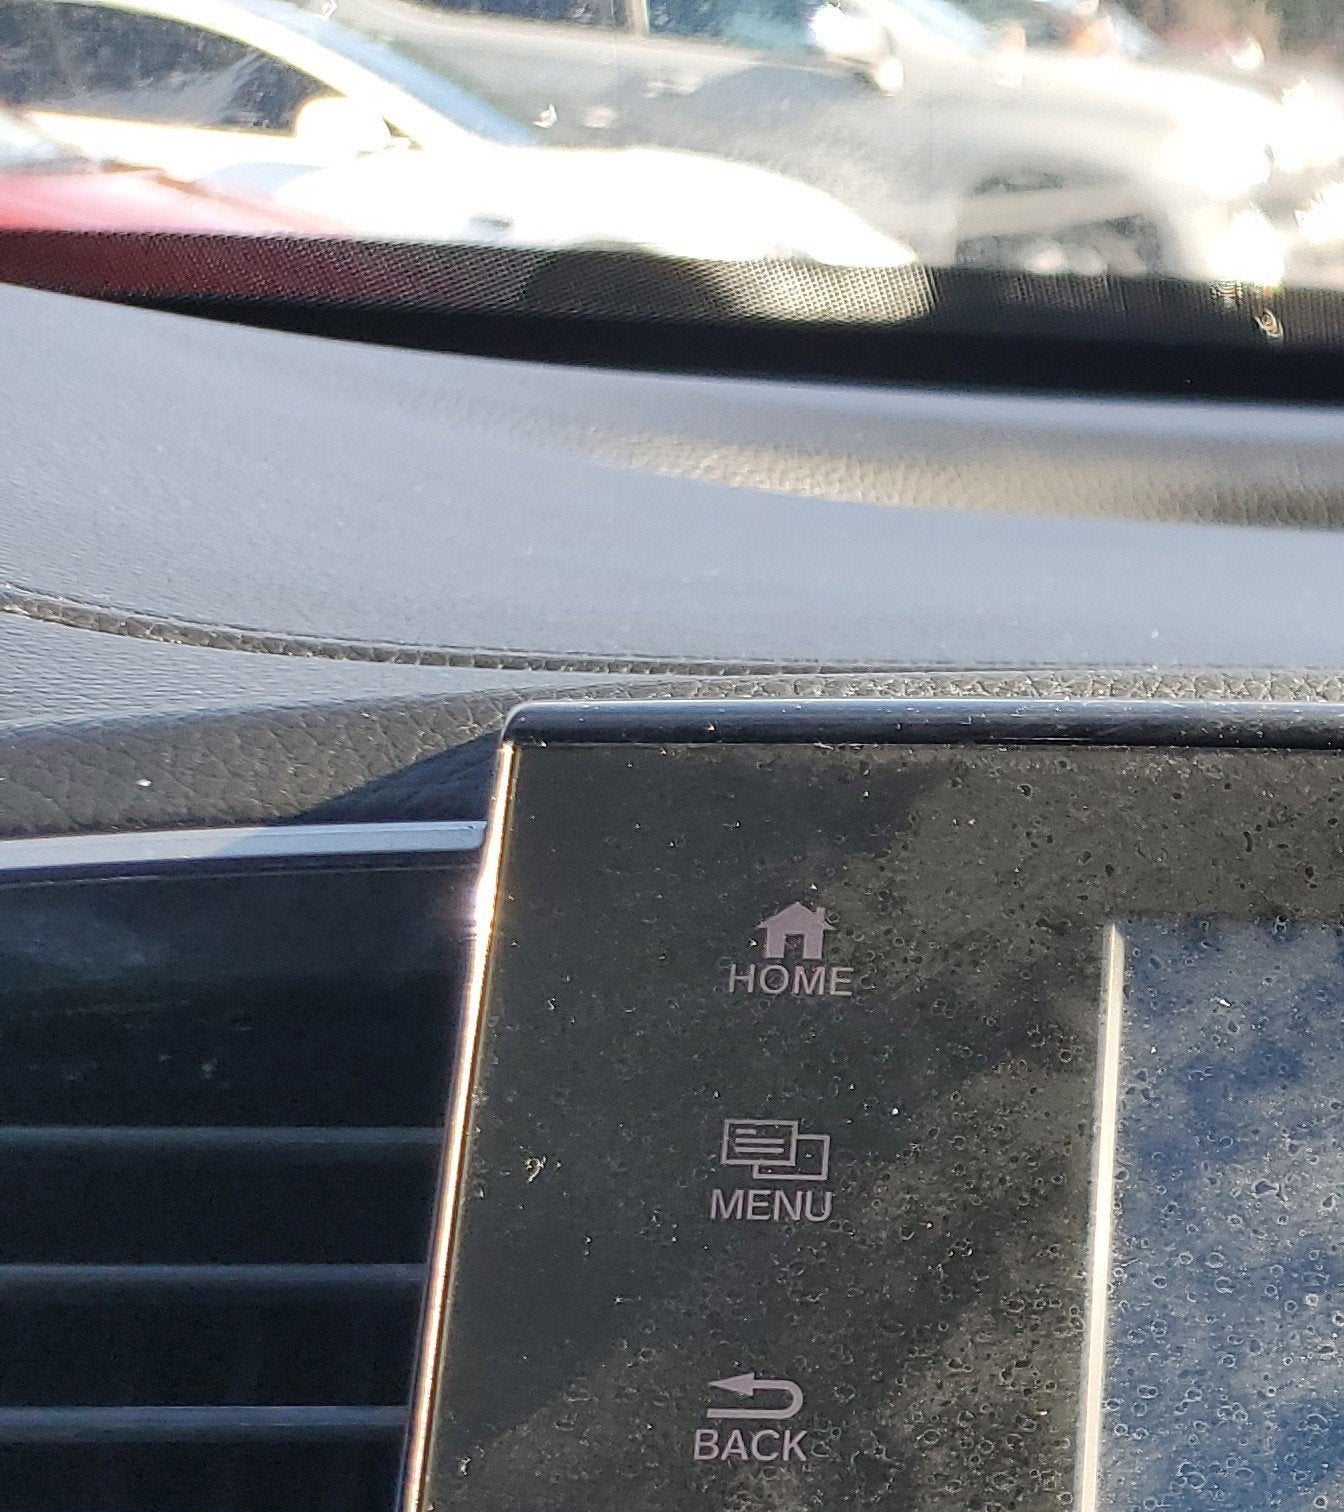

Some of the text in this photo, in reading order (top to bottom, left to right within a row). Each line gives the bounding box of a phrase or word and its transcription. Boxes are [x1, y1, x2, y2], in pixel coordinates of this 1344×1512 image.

[728, 963, 854, 996] HOME
[710, 1188, 833, 1222] MENU
[693, 1429, 808, 1462] BACK
